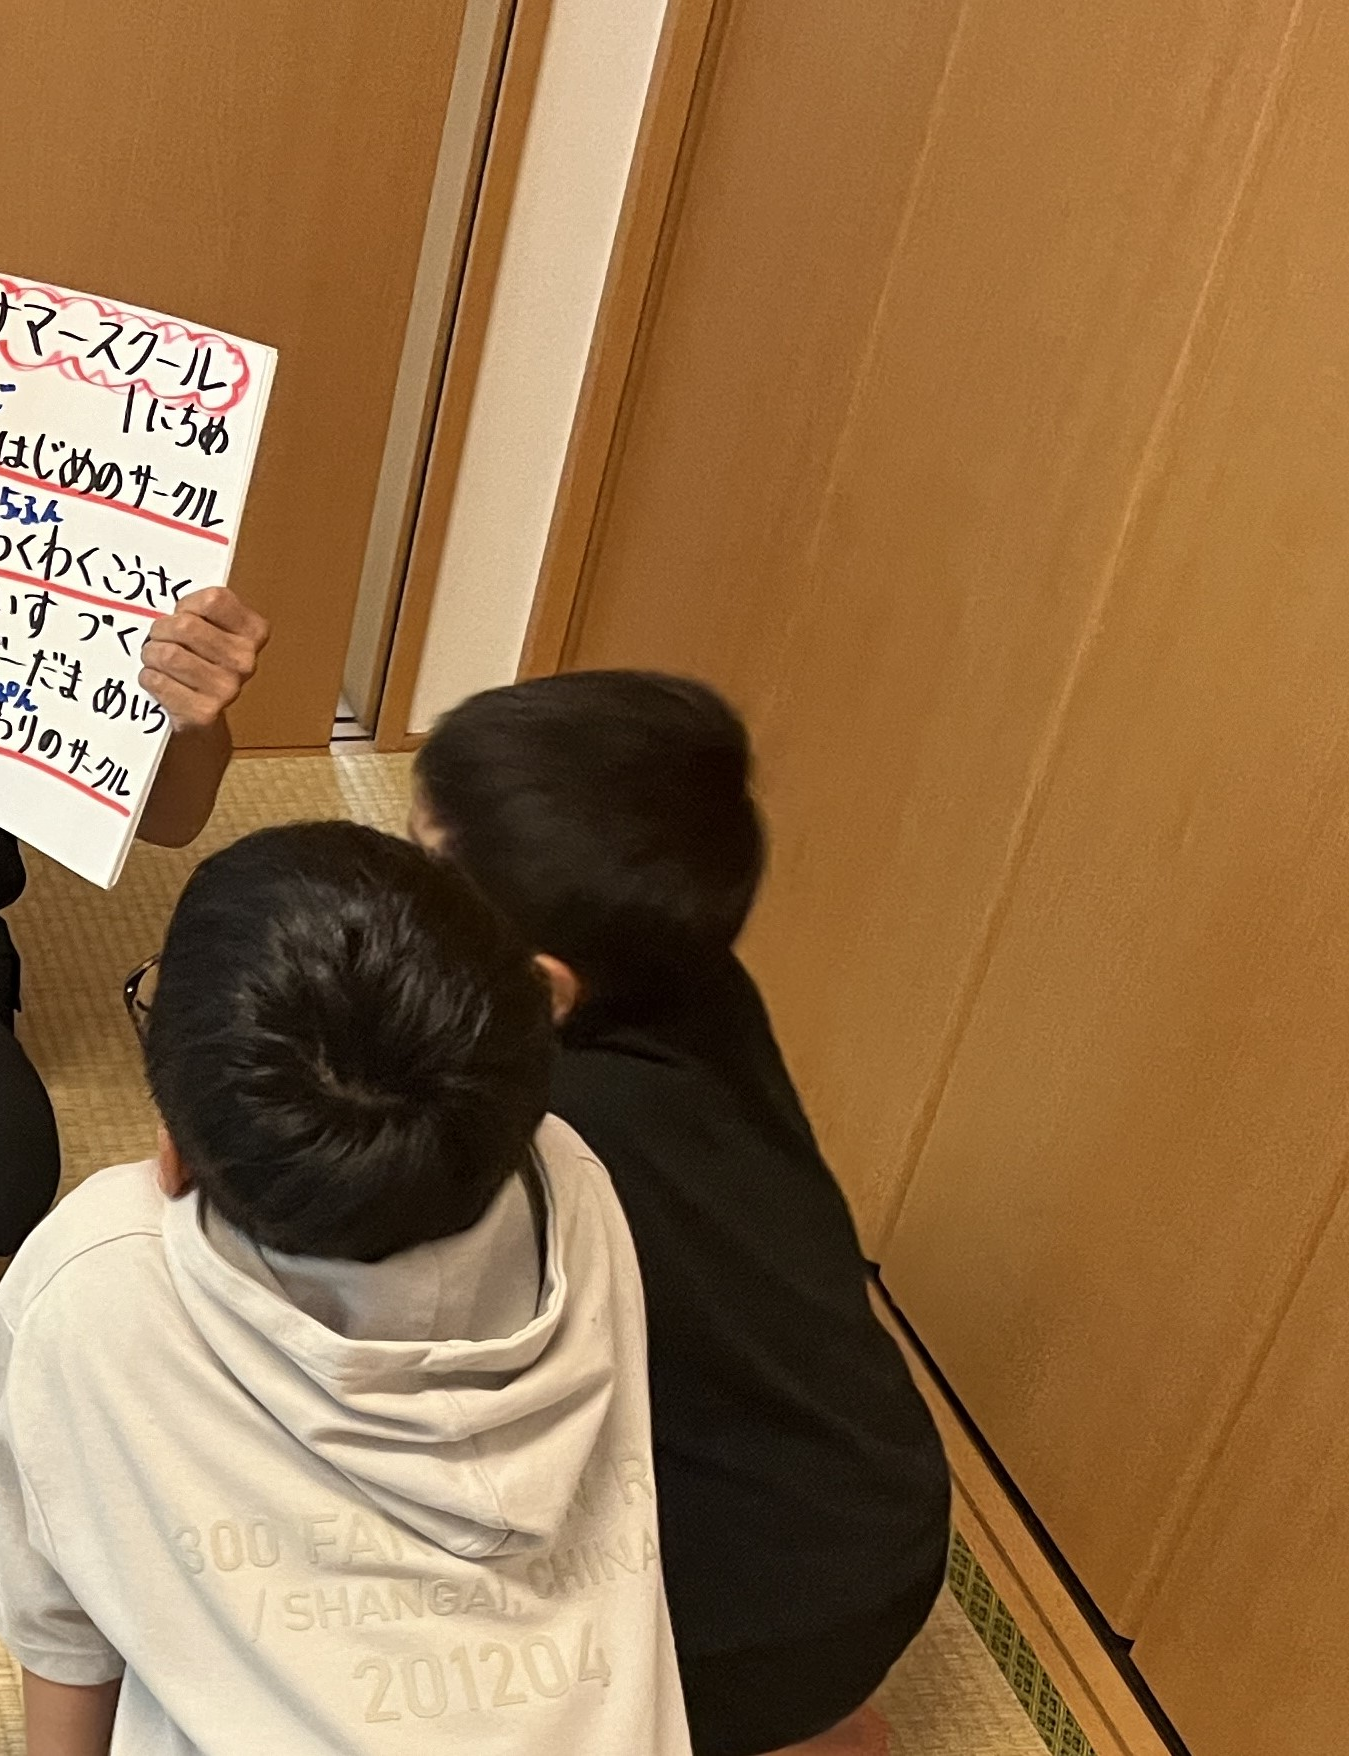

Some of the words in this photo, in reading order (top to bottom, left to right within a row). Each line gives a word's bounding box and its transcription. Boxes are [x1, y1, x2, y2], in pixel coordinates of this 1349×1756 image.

[122, 384, 229, 456] 1にちめ
[169, 1517, 281, 1576] 300
[525, 1526, 658, 1600] CHINA
[351, 1621, 613, 1725] 201204
